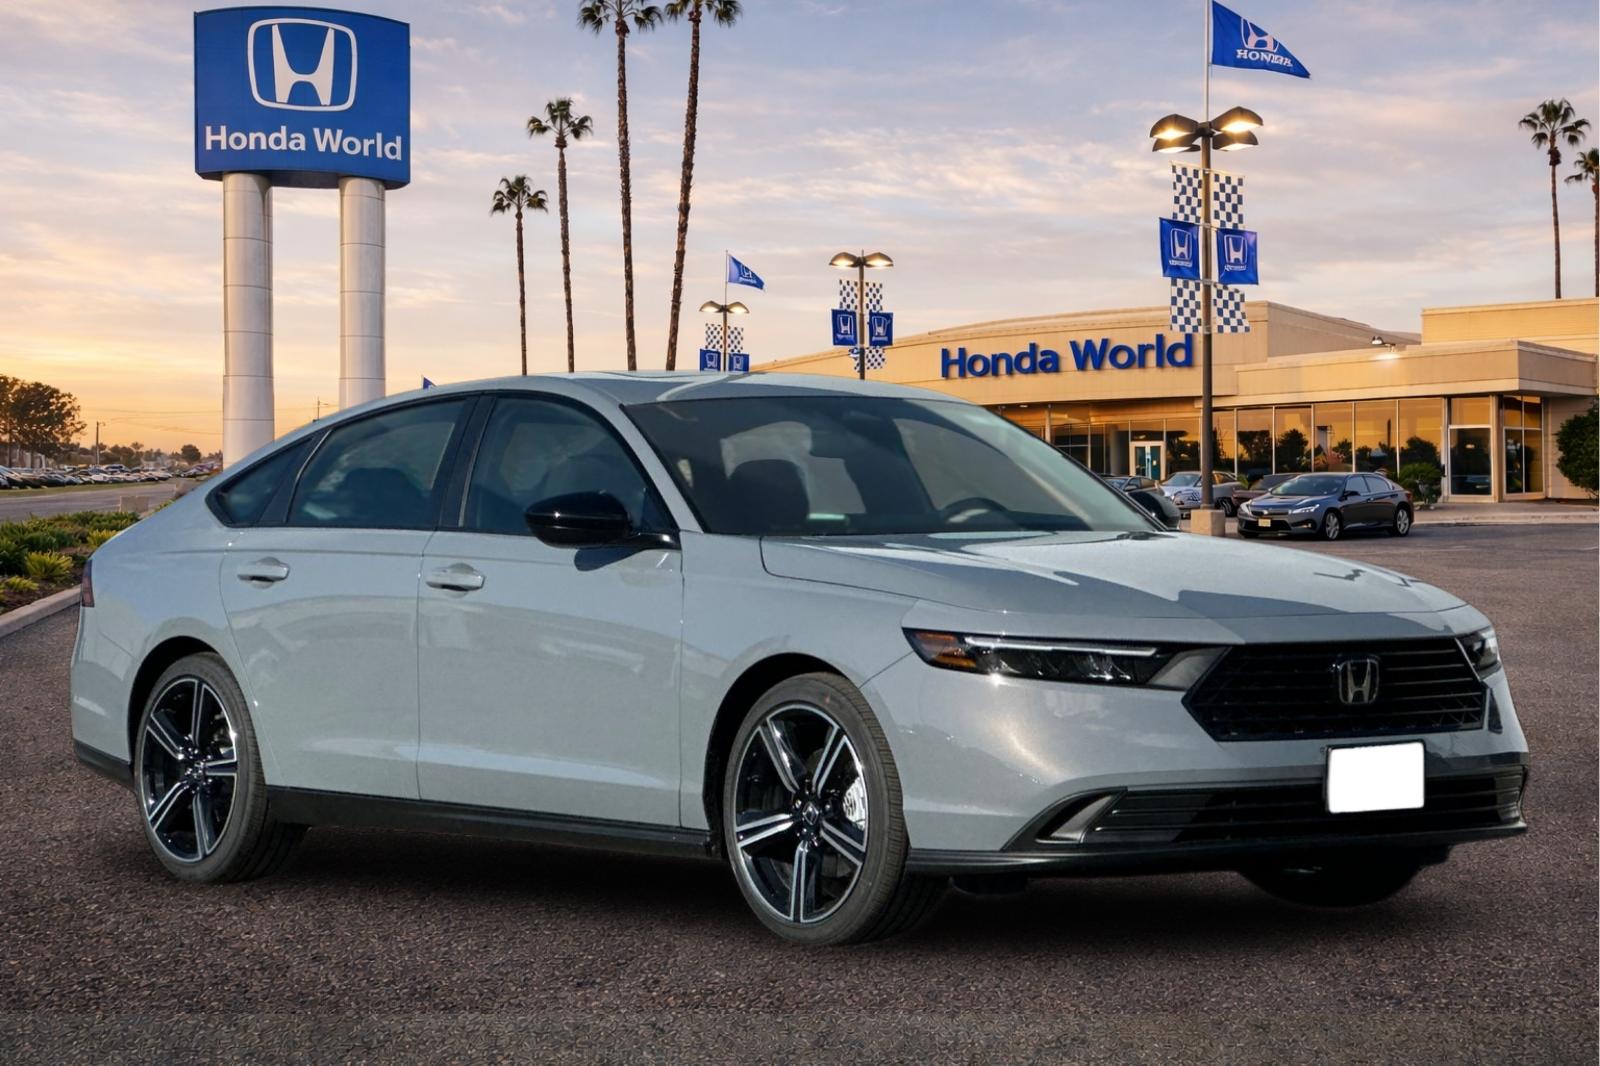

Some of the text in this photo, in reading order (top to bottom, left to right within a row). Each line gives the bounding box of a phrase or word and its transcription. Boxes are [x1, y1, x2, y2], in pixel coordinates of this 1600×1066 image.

[205, 125, 402, 161] Honda World
[941, 333, 1194, 379] Honda World
